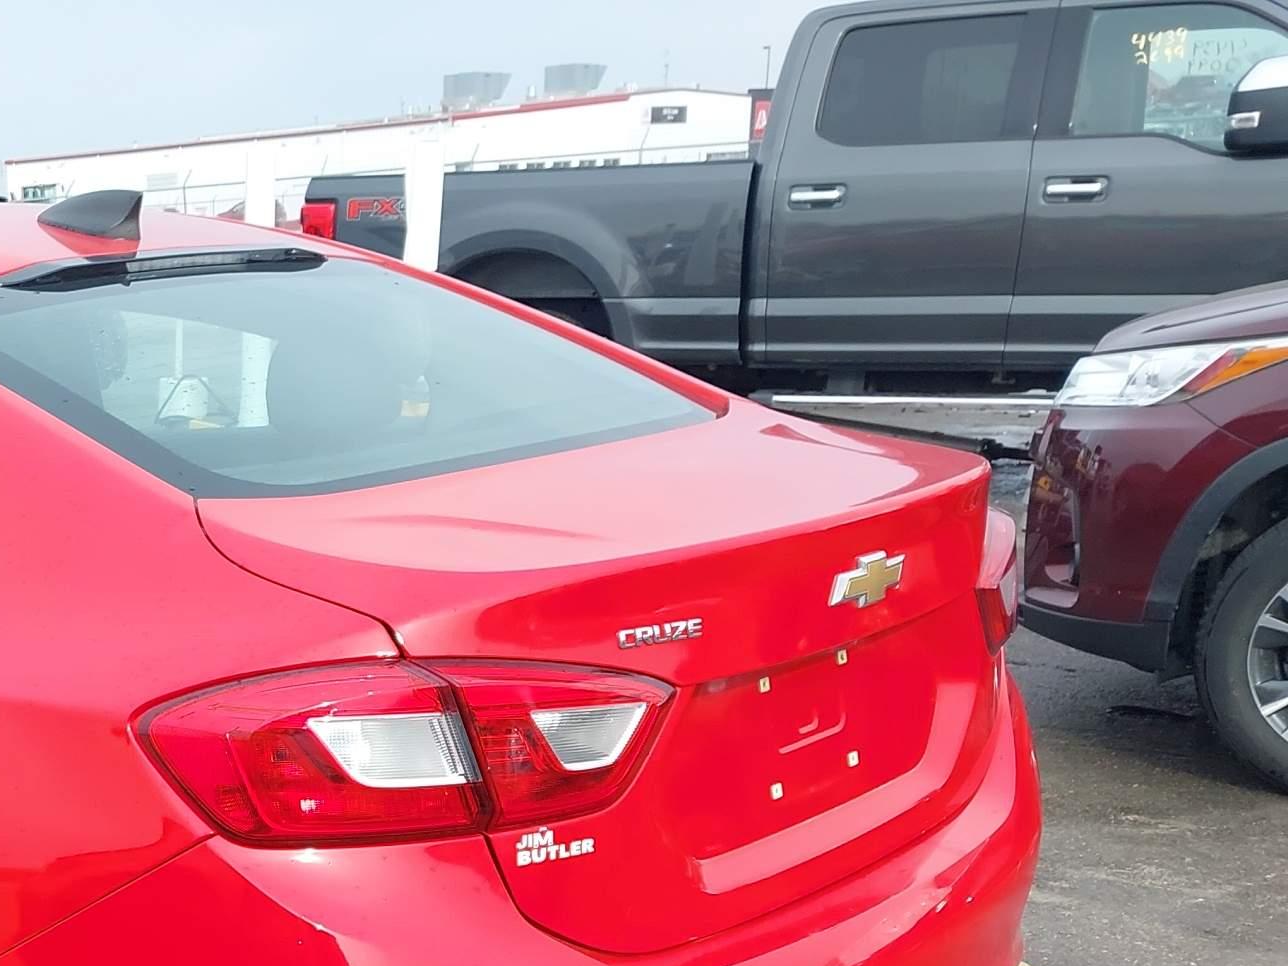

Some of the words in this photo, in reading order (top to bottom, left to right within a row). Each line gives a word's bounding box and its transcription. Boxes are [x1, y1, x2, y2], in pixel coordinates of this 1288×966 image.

[616, 617, 703, 649] CRUZE
[515, 828, 554, 850] JIM
[515, 838, 596, 867] BUTLER
